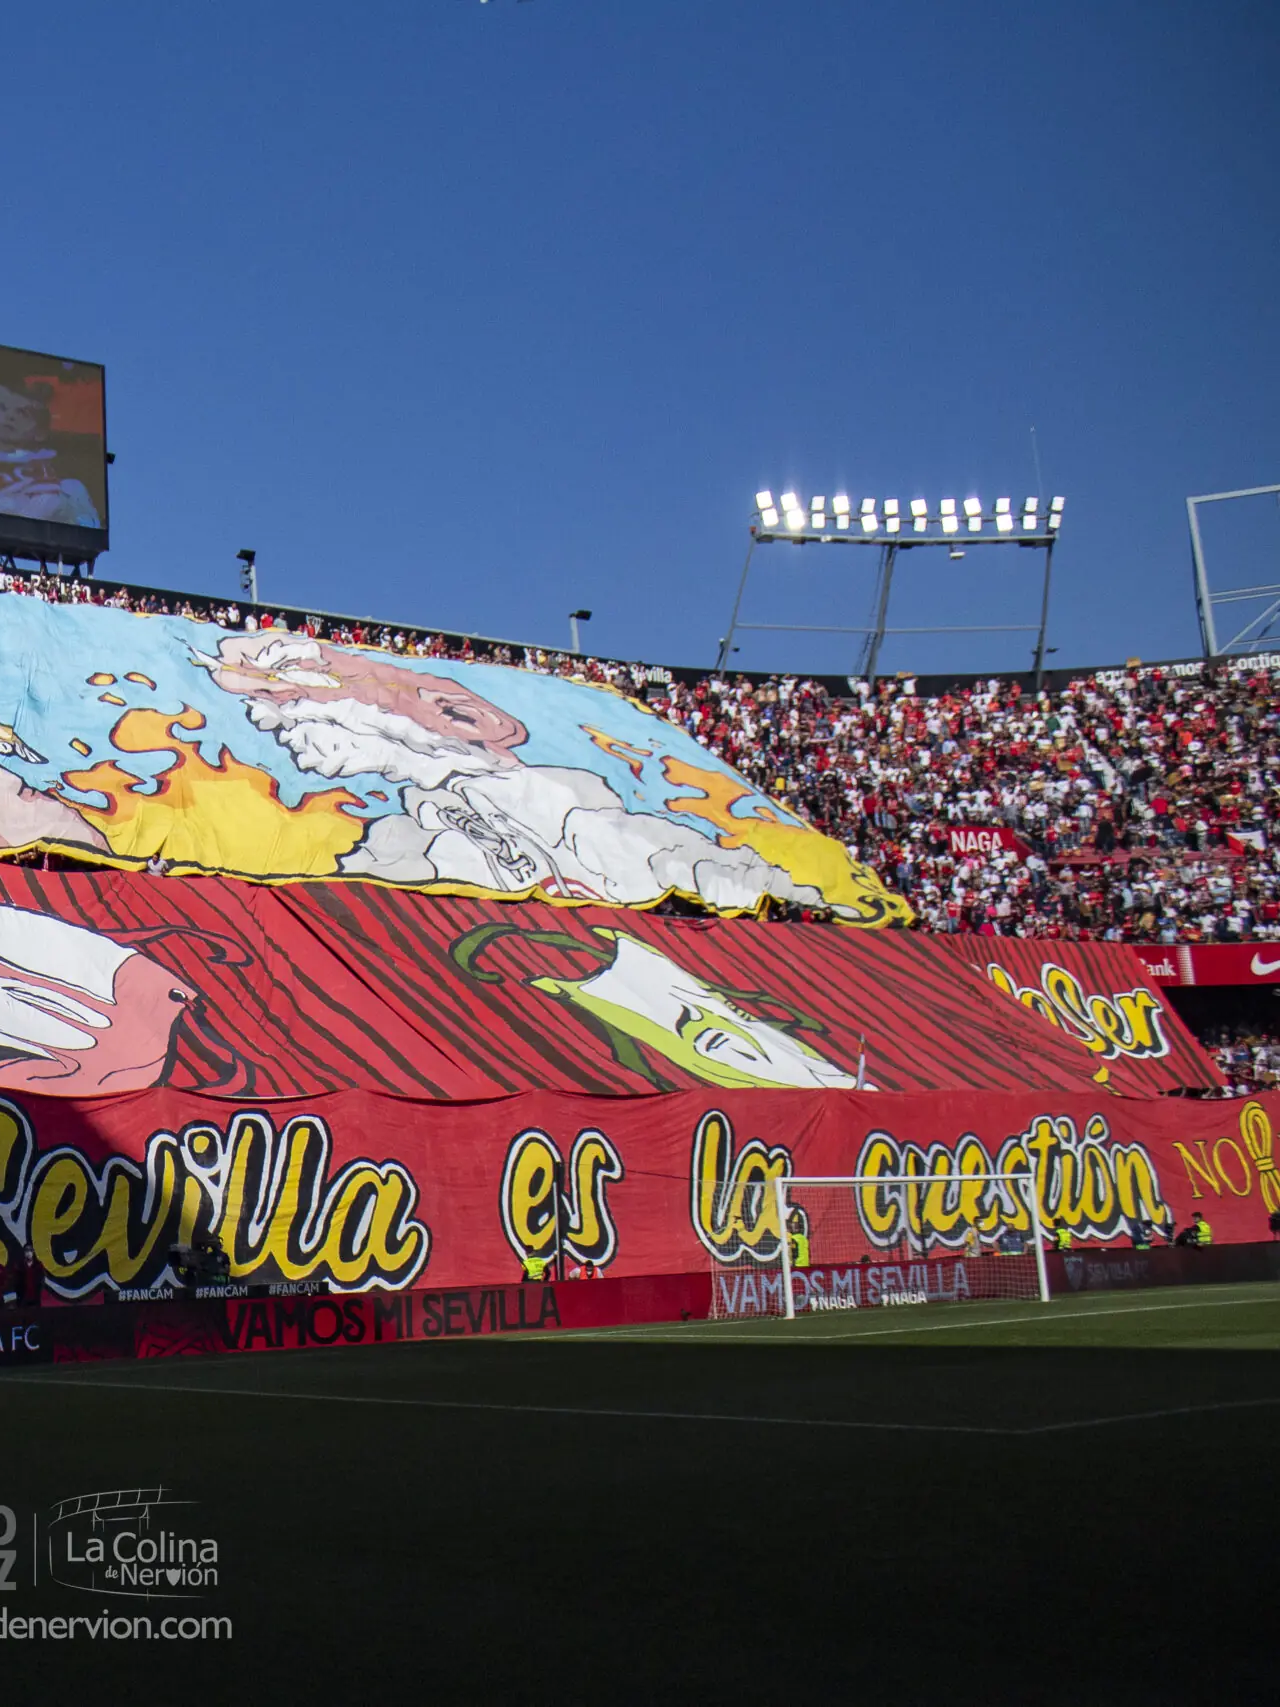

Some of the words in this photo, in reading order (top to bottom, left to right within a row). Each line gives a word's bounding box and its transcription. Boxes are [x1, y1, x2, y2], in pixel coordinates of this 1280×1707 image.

[950, 830, 1003, 852] NAGA
[1140, 958, 1177, 976] ank
[500, 1127, 624, 1268] es
[689, 1109, 809, 1265] la
[118, 1287, 174, 1302] #FANCAM
[195, 1285, 249, 1300] #FANCAM
[268, 1281, 320, 1296] #FANCAM
[720, 1269, 824, 1314] VAMOS
[832, 1268, 861, 1305] MI
[867, 1262, 971, 1304] SEVILLA
[223, 1298, 366, 1350] VAMOS
[374, 1293, 414, 1341] MI
[422, 1286, 562, 1337] SEVILLA
[11, 1324, 40, 1351] FC
